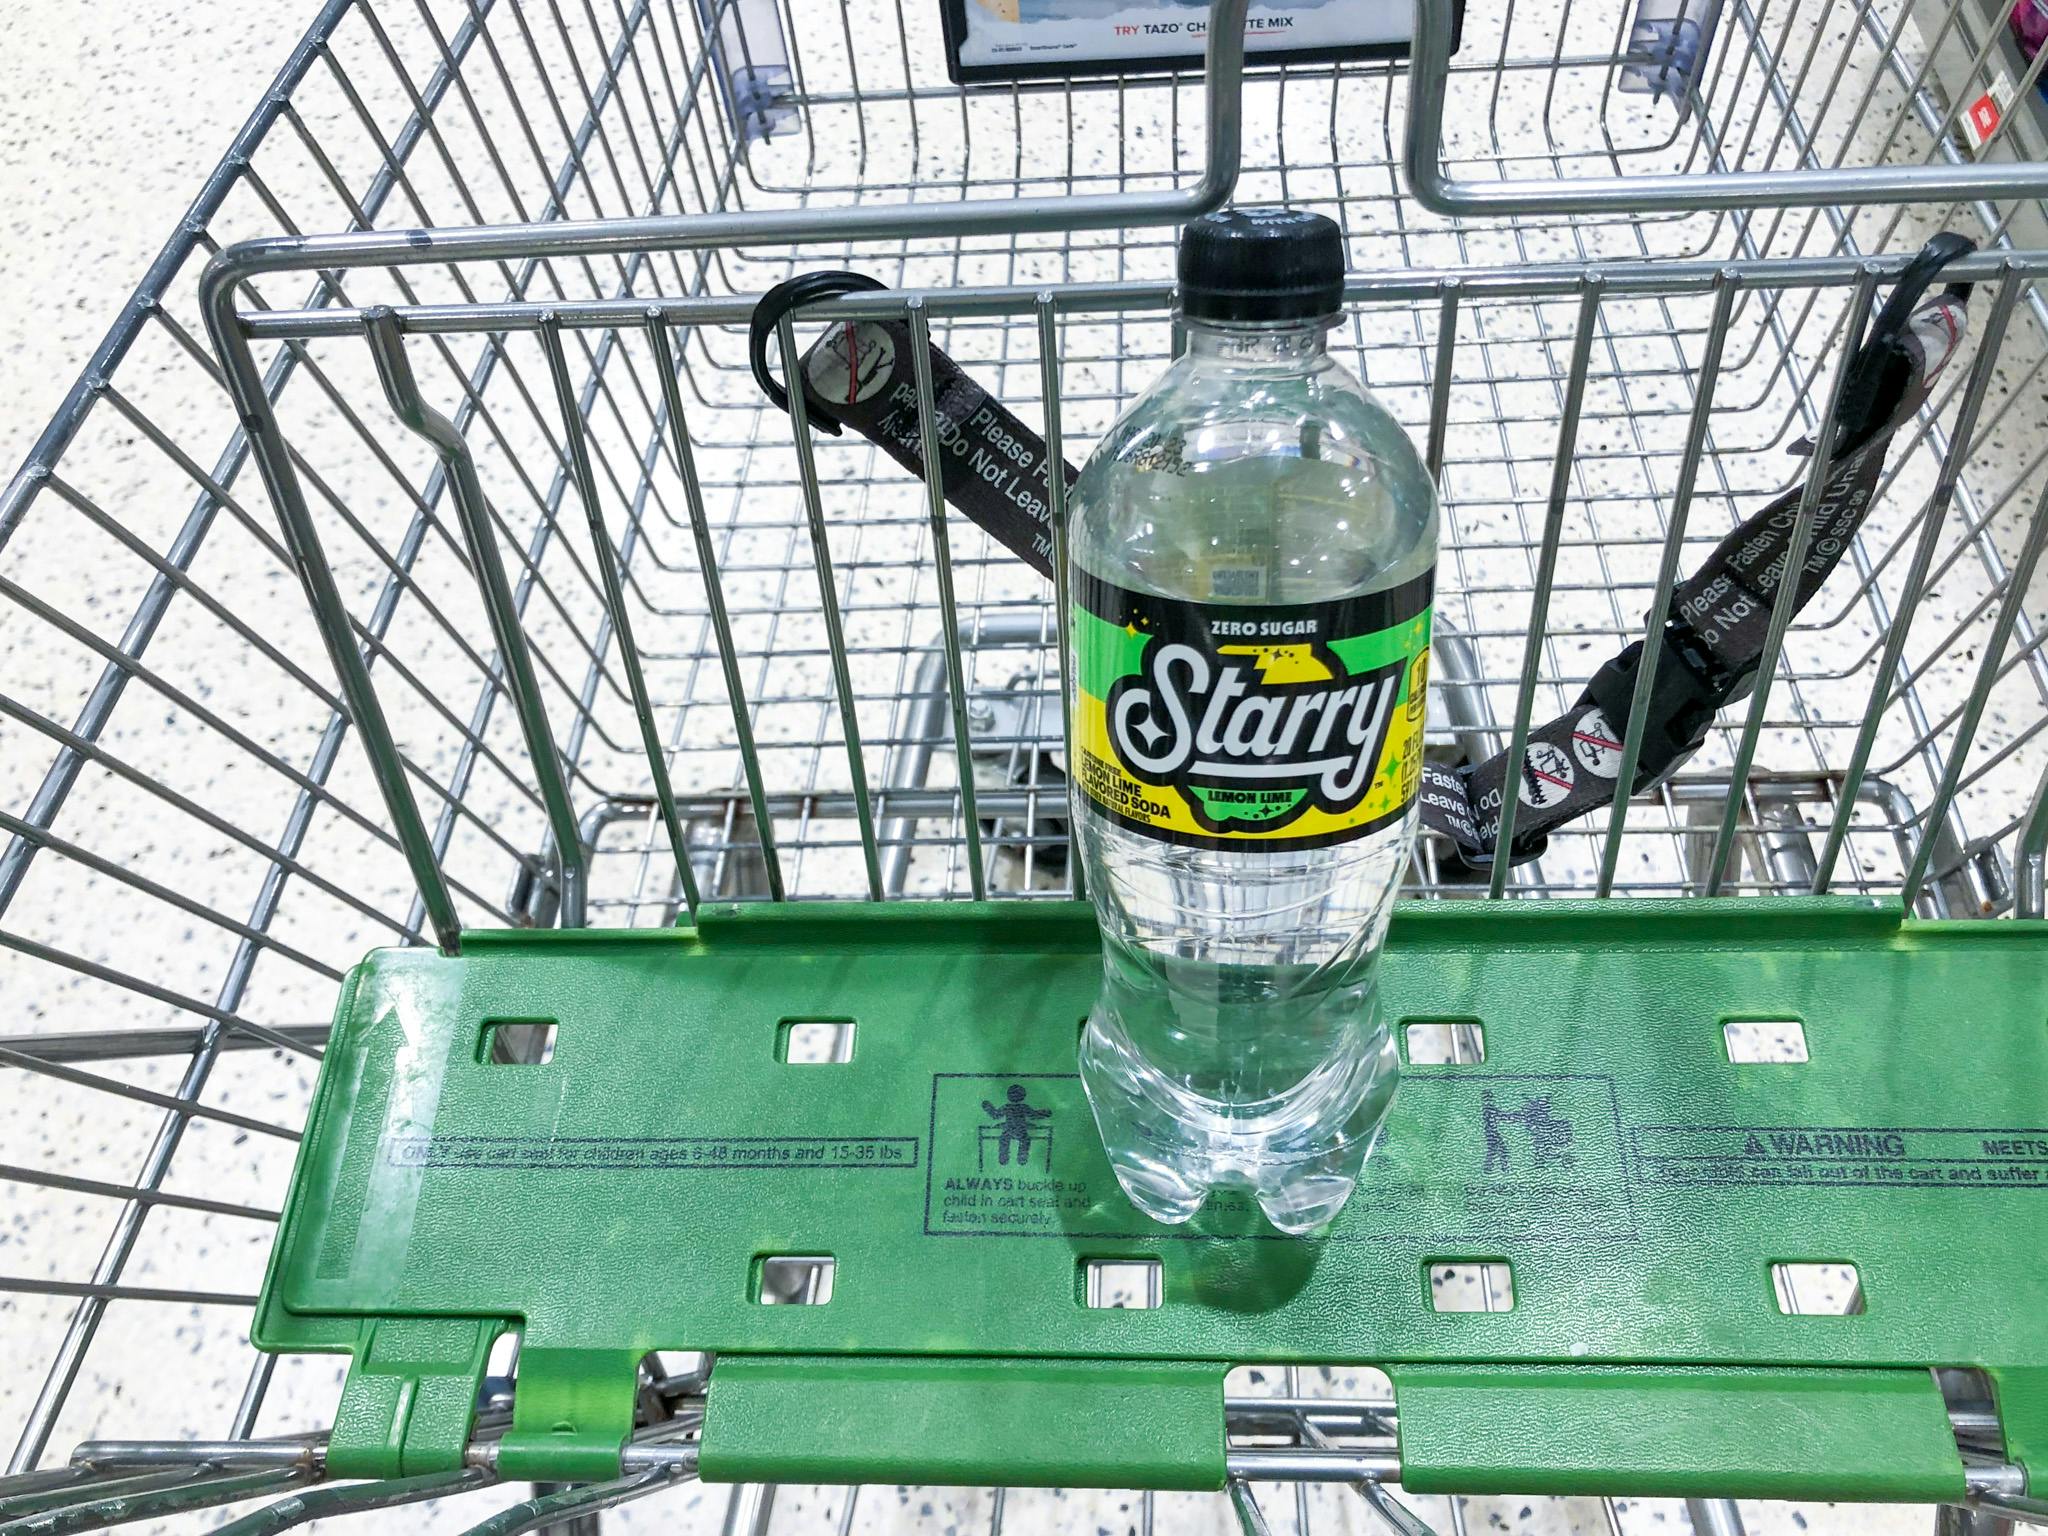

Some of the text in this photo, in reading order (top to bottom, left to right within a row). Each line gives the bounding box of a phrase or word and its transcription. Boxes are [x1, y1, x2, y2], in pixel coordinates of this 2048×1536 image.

[1114, 25, 1140, 36] TRY
[1268, 17, 1294, 28] MIX
[969, 407, 1034, 468] Please
[967, 447, 1008, 489] Not
[1712, 593, 1759, 631] Not
[1211, 619, 1319, 636] ZERO SUGAR
[1114, 643, 1397, 801] Starry
[1081, 767, 1171, 819] FLAVORED SODA
[1113, 777, 1142, 798] LIME
[1207, 789, 1293, 804] LEMON LIME
[1770, 1134, 1906, 1156] WARNING
[1981, 1139, 2048, 1156] MEETS
[650, 1148, 688, 1164] ages
[732, 1146, 790, 1160] months
[795, 1146, 824, 1160] and
[832, 1146, 875, 1160] 15-35
[1874, 1166, 1903, 1179] the
[1908, 1167, 1944, 1180] cart
[1948, 1166, 1982, 1180] and
[1986, 1166, 2039, 1180] suffer
[944, 1177, 1087, 1193] ALWAYS buckle up
[943, 1194, 976, 1207] child
[980, 1194, 993, 1207] in
[998, 1195, 1025, 1208] cart
